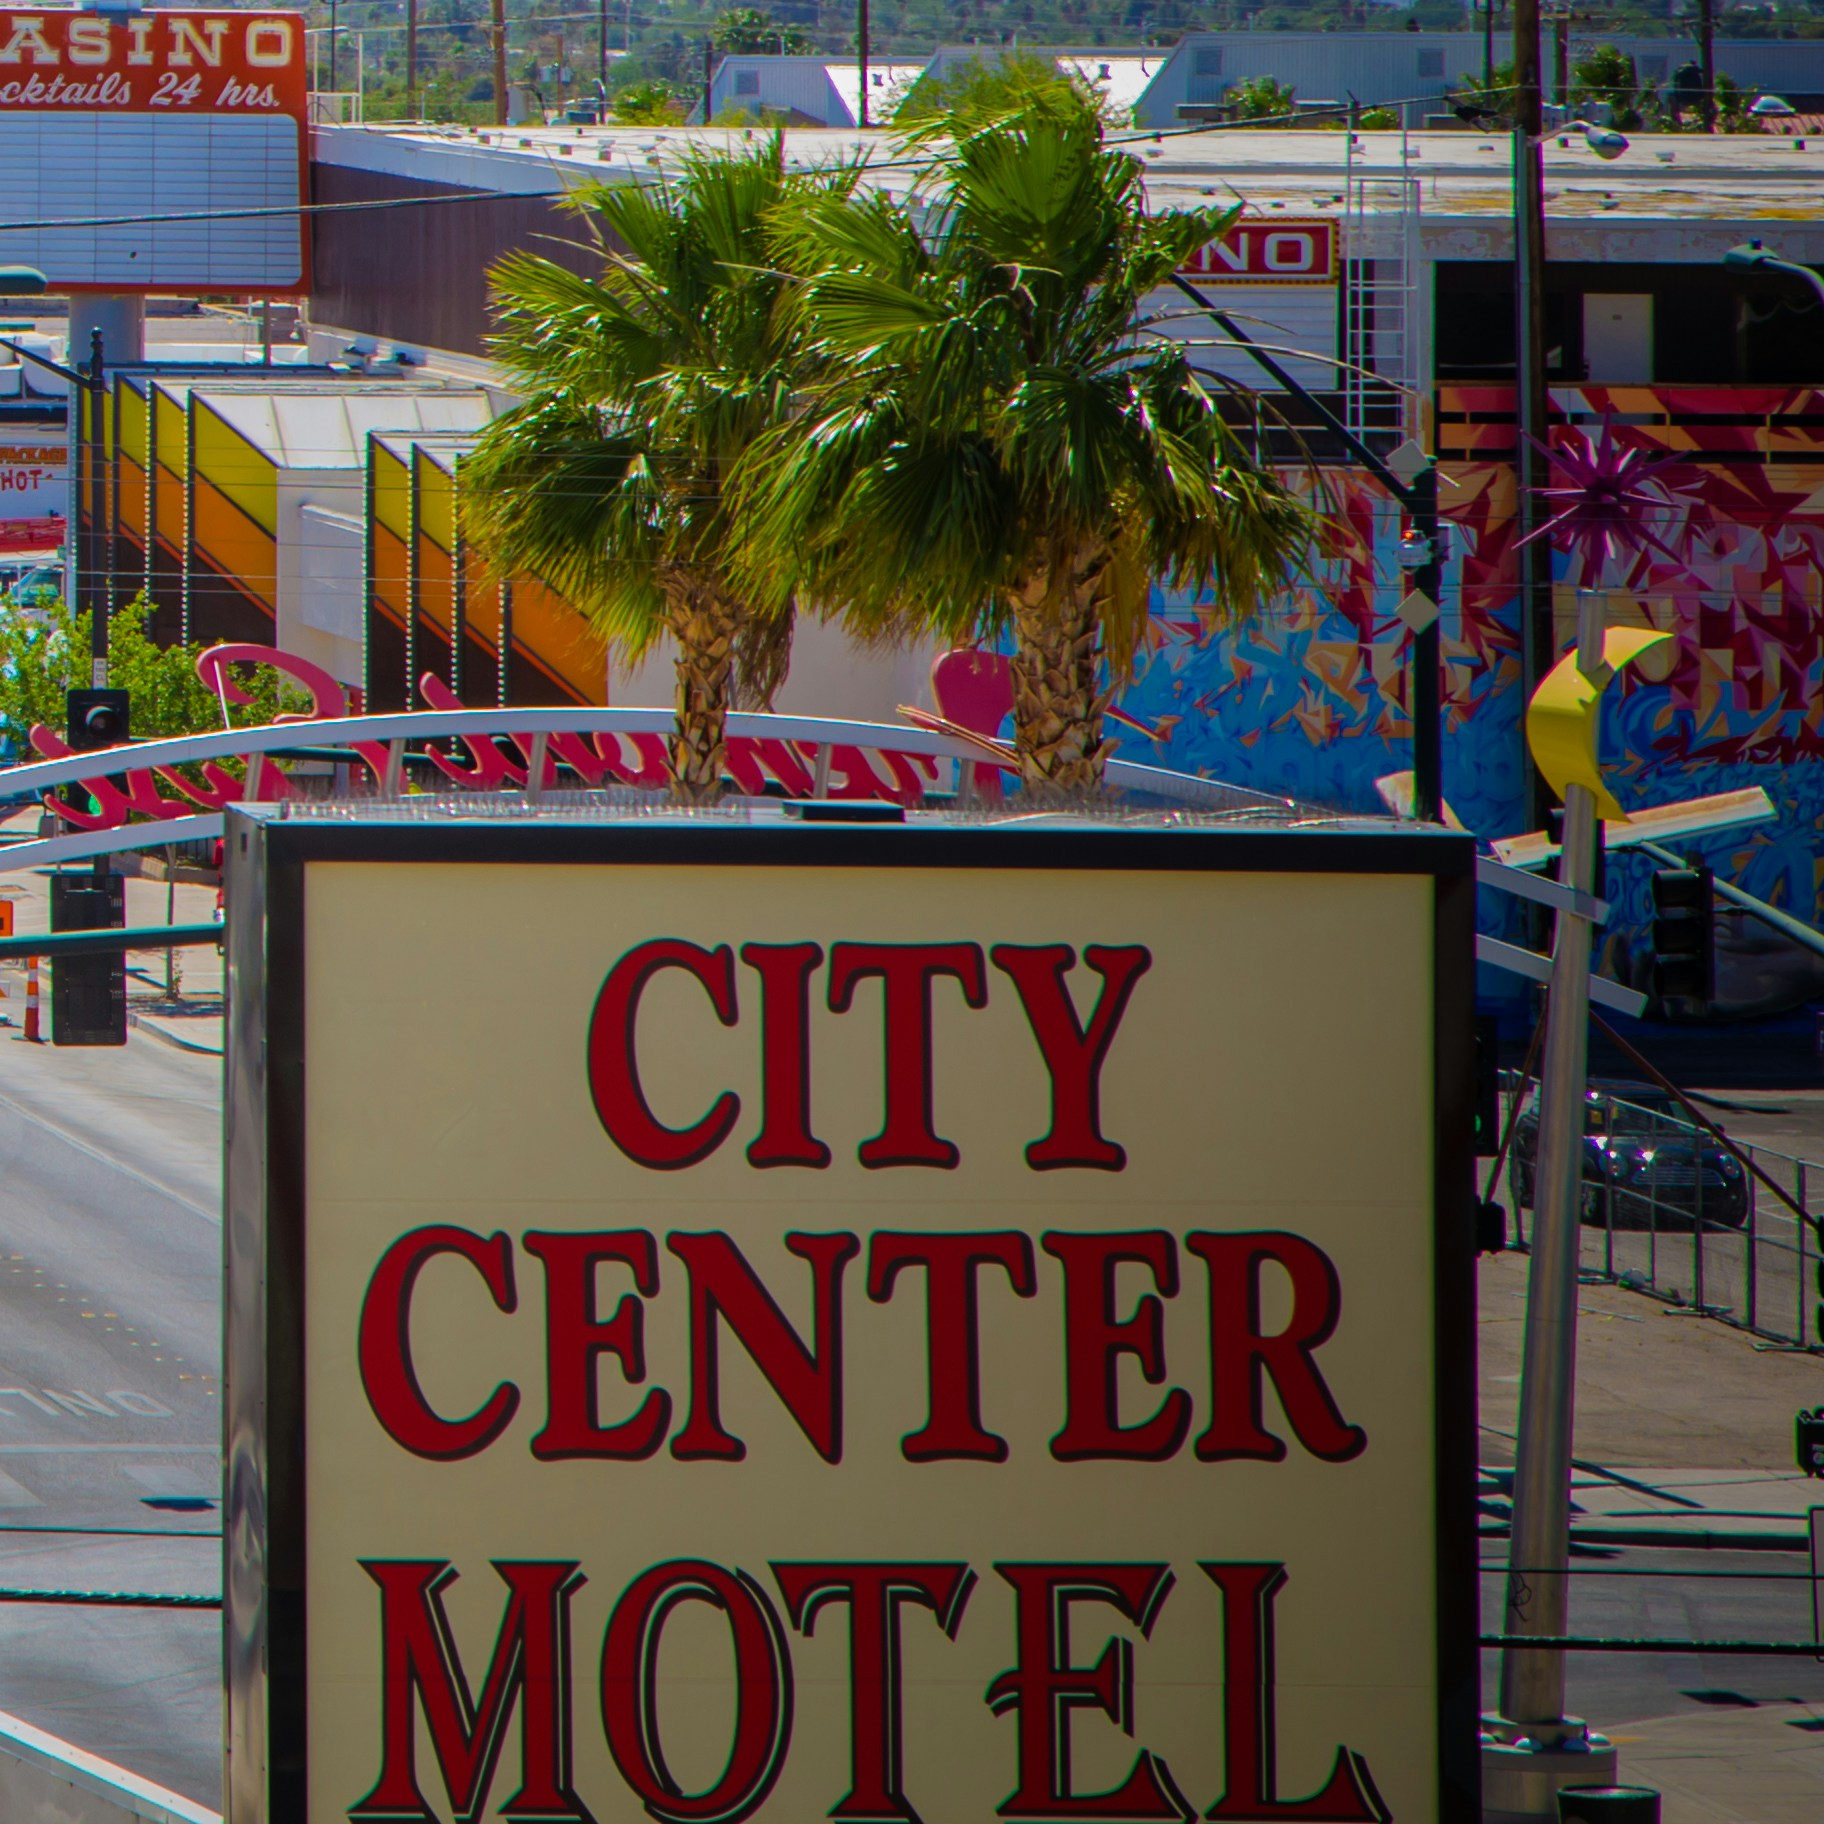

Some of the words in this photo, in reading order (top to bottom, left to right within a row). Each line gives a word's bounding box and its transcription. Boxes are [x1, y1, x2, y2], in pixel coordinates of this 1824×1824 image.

[149, 72, 203, 105] 24
[215, 75, 281, 107] hrs.
[1176, 232, 1314, 272] NO
[0, 469, 43, 491] HOT
[587, 936, 1152, 1173] CITY
[357, 1223, 1368, 1465] CENTER
[346, 1556, 1395, 1824] MOTEL
